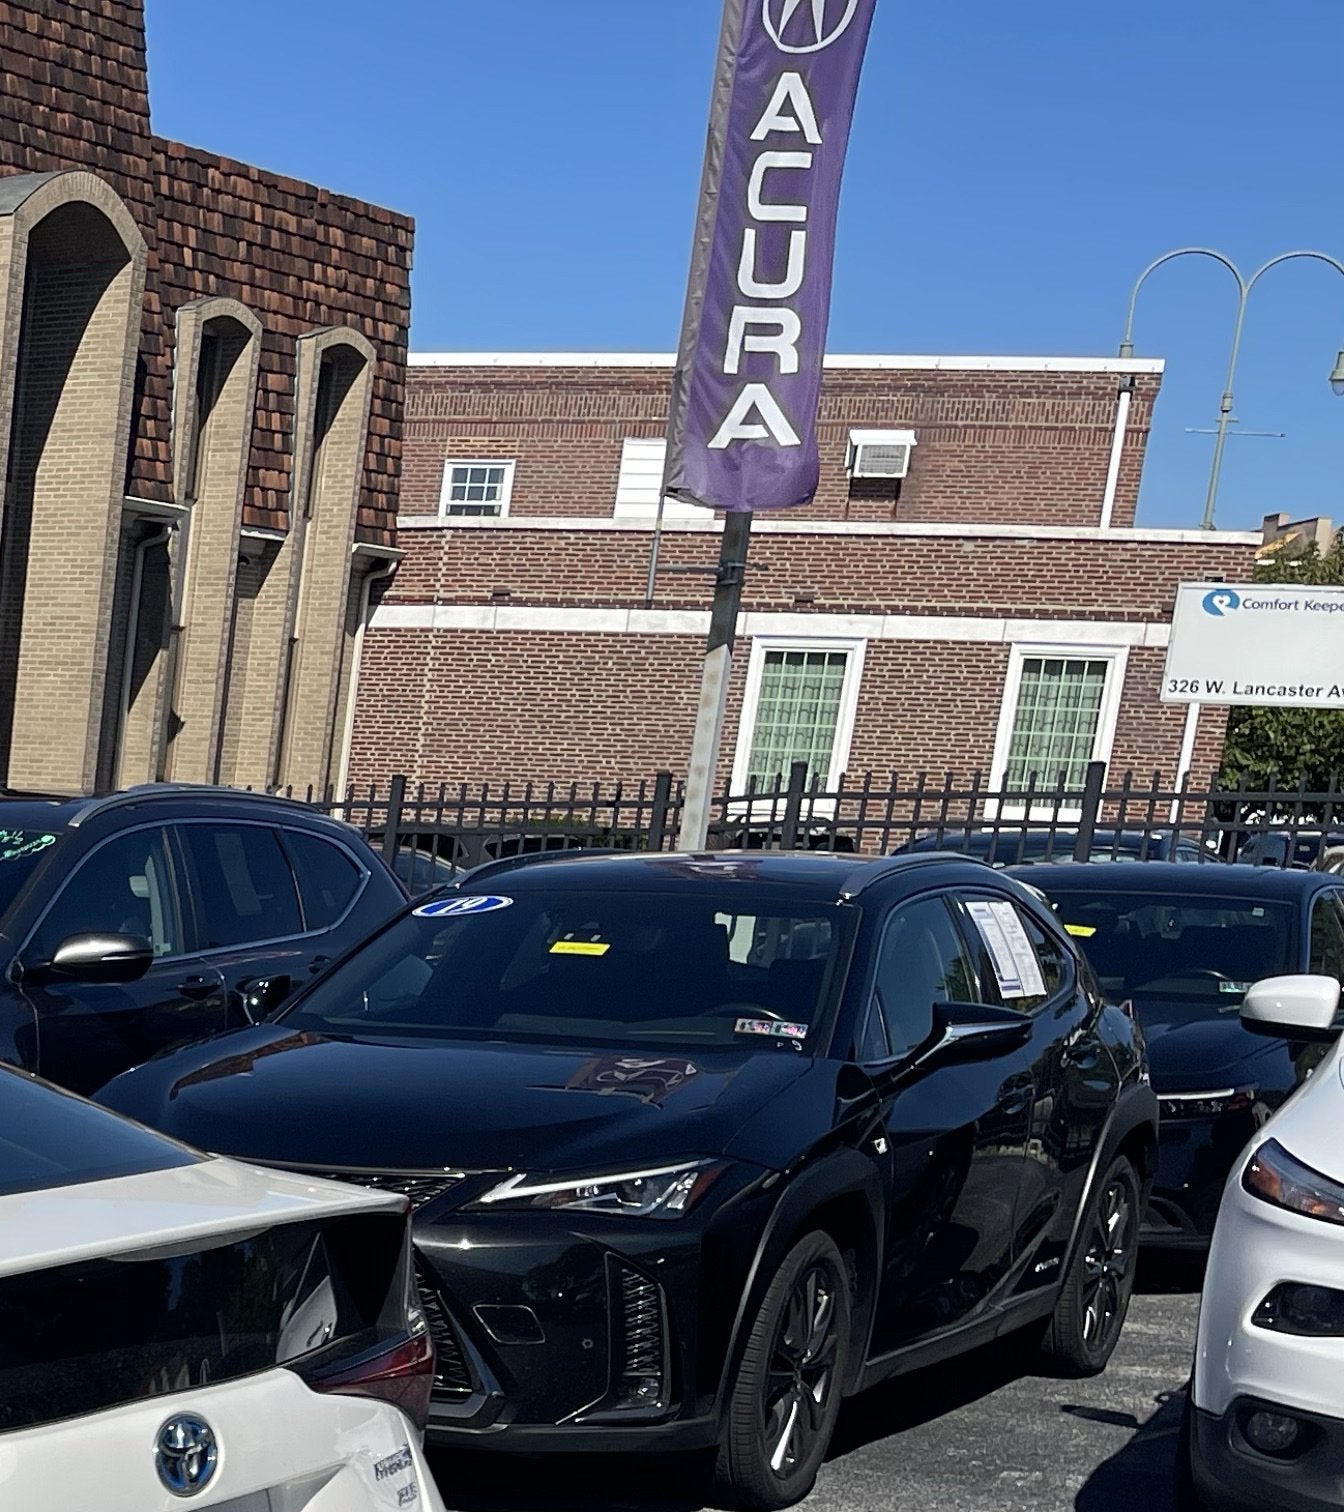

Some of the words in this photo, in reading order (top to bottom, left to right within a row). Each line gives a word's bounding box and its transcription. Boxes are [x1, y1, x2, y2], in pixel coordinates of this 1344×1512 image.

[707, 71, 823, 449] ACURA
[1242, 598, 1299, 611] Comfort
[1168, 680, 1200, 694] 326
[1206, 681, 1226, 694] W.
[1233, 681, 1323, 698] Lancaster
